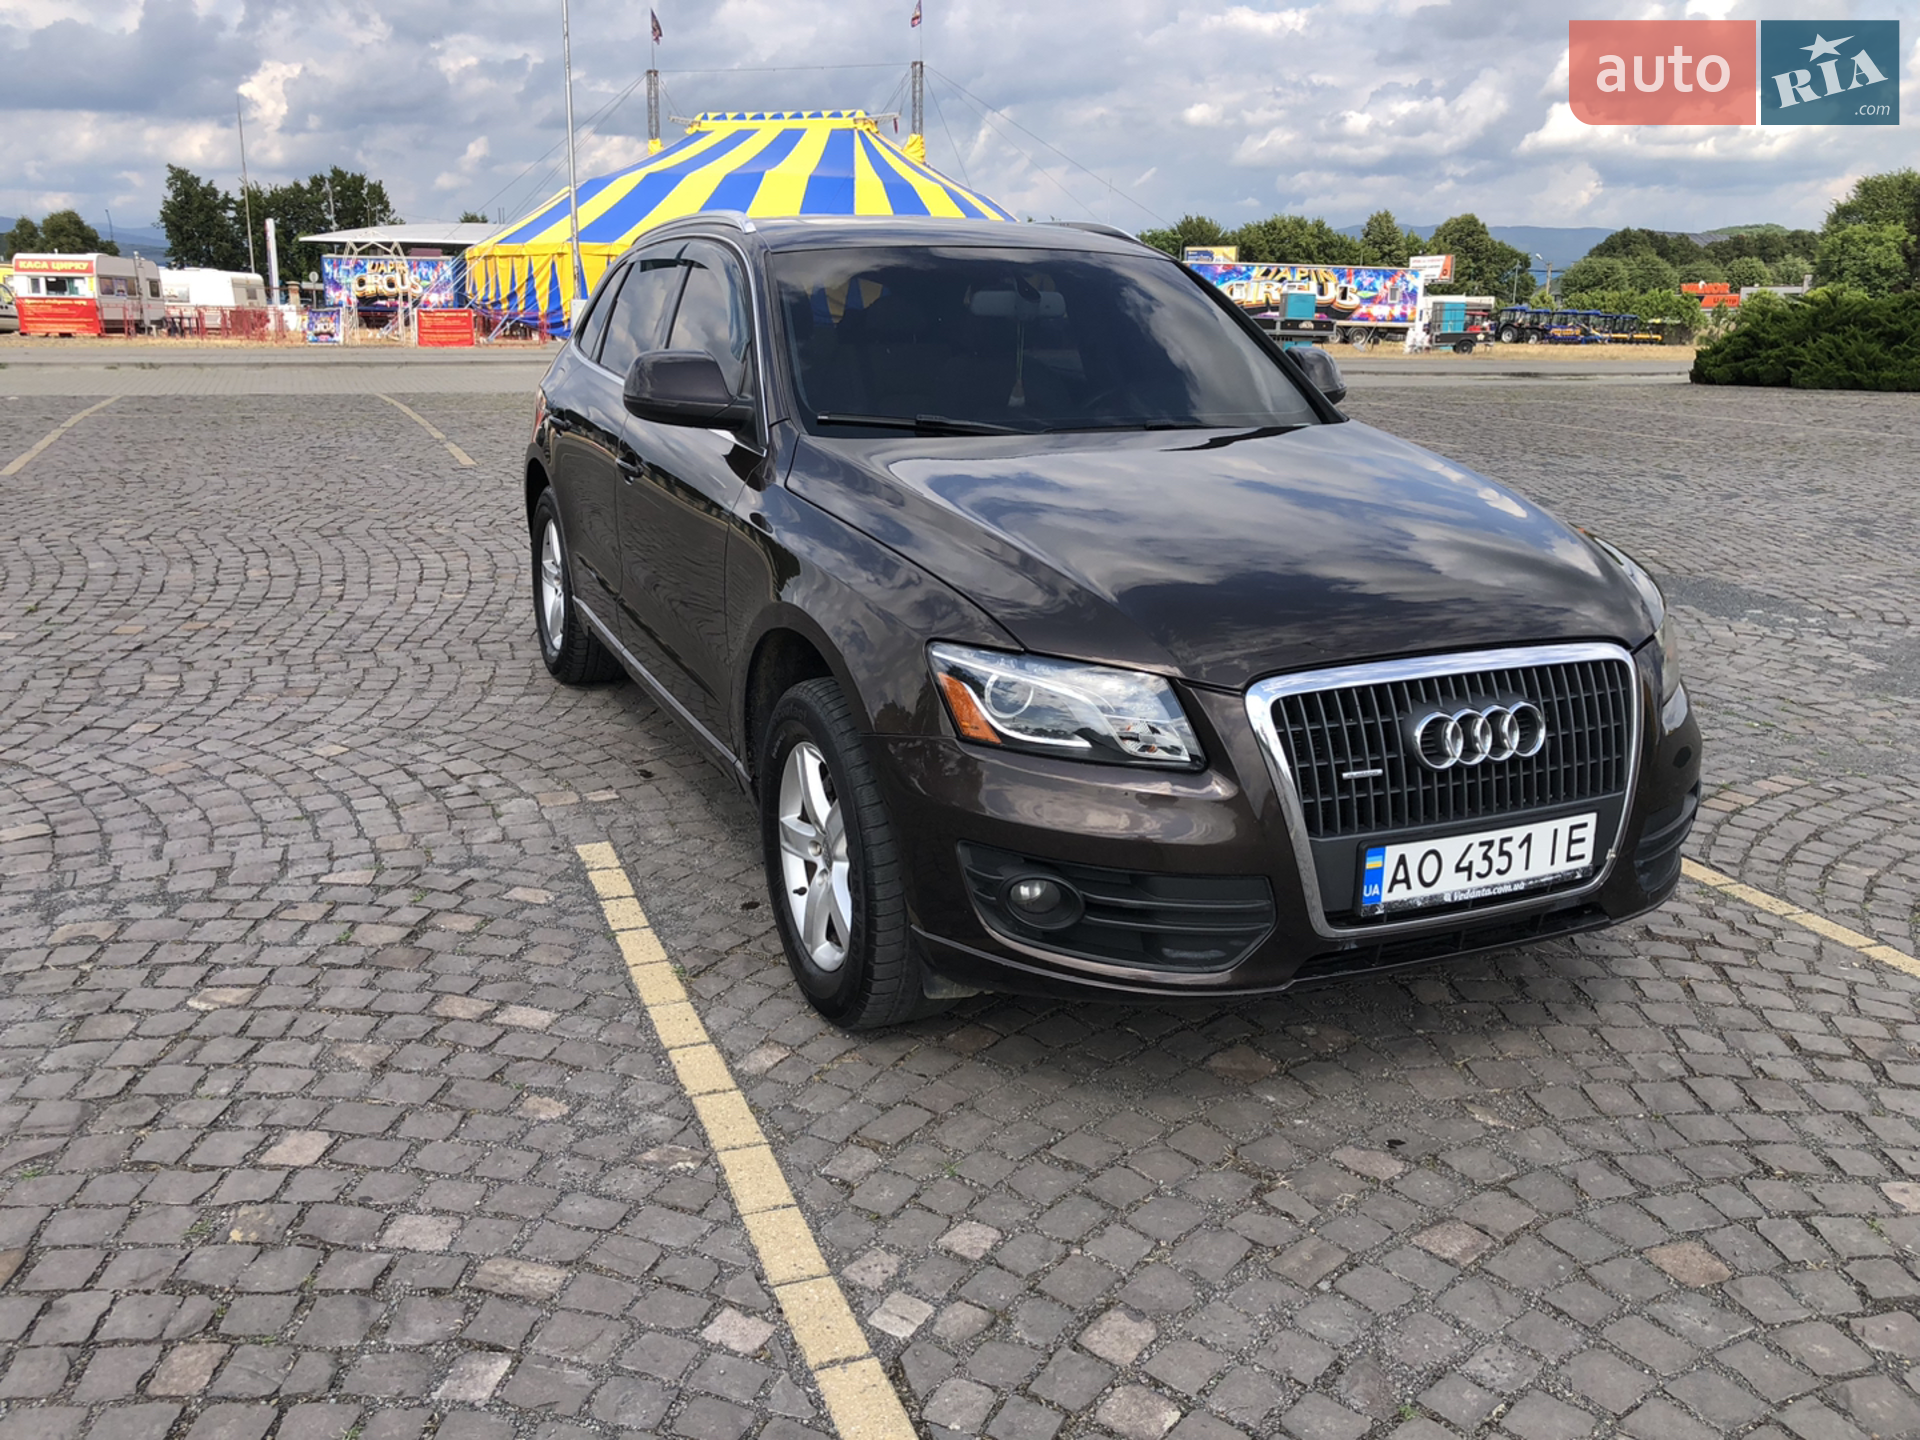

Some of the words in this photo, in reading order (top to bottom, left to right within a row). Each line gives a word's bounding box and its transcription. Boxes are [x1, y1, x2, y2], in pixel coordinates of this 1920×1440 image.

[19, 261, 49, 270] КАСА
[51, 262, 88, 271] ЦИРКУ
[354, 274, 423, 295] CIRCUS
[1219, 280, 1361, 310] CIRUS
[1387, 848, 1443, 894] AO
[1454, 832, 1533, 882] 4351
[1550, 822, 1589, 867] IE
[1363, 884, 1381, 897] UA
